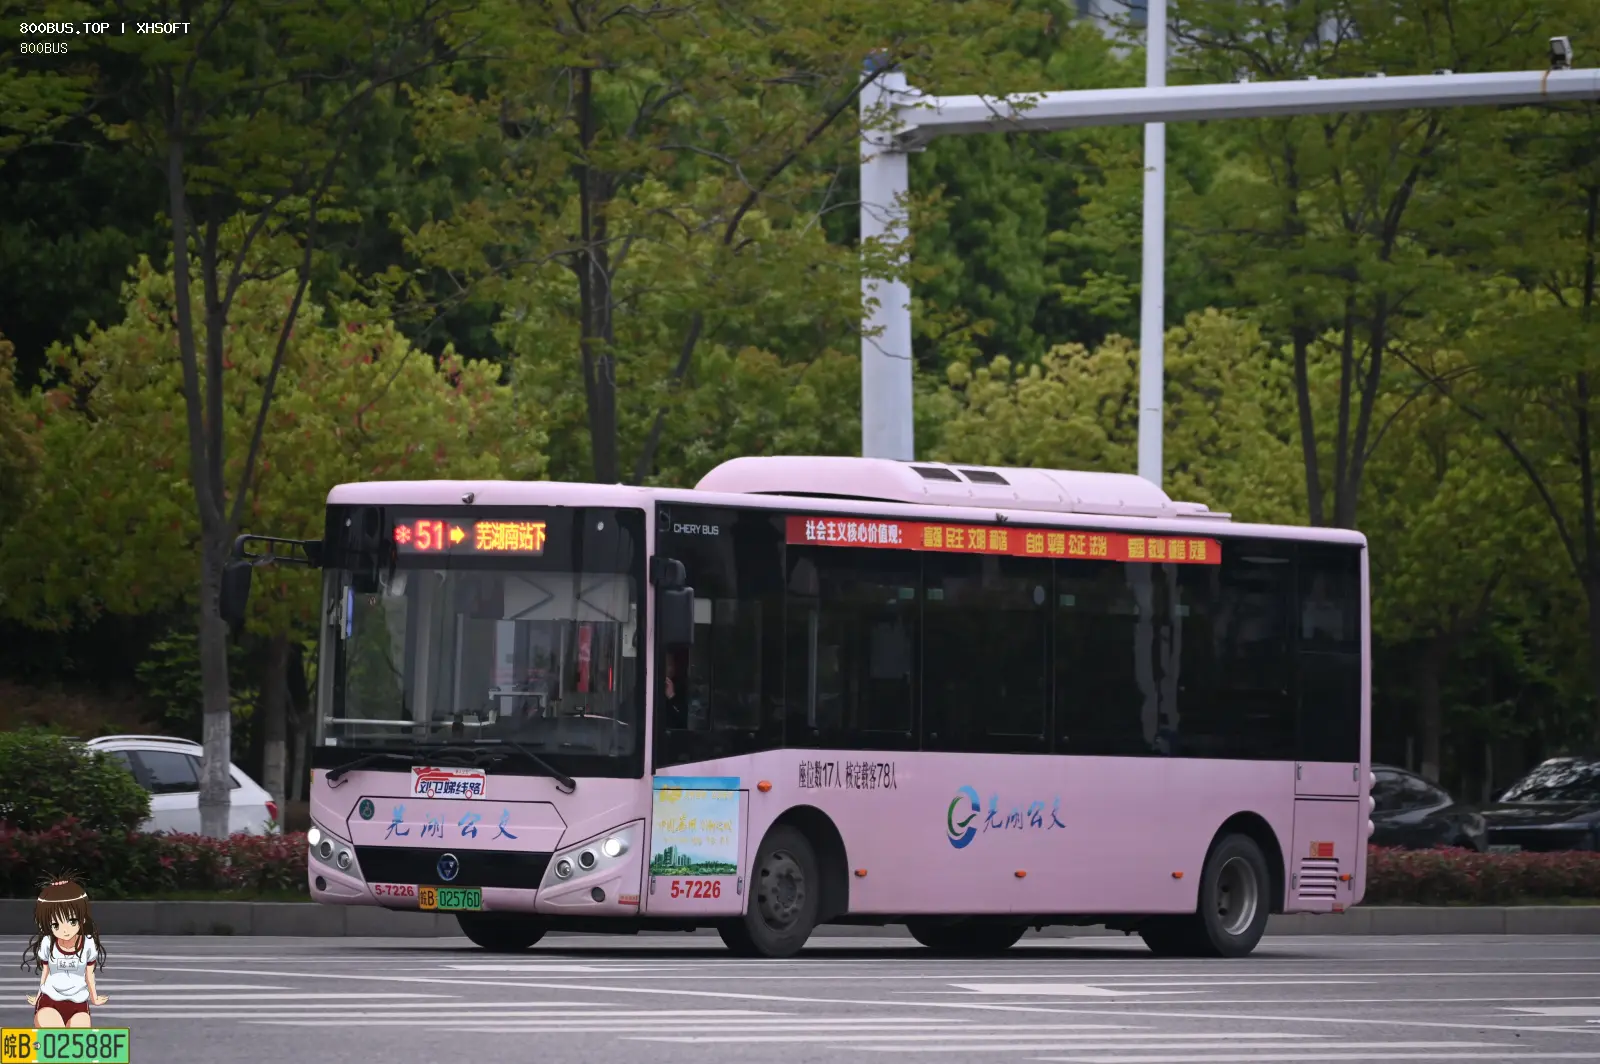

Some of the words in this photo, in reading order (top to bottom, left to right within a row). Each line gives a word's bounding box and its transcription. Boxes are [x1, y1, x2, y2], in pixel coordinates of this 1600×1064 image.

[415, 520, 443, 550] 51
[673, 523, 701, 534] CHERY
[702, 525, 719, 535] BUS
[375, 885, 414, 897] 5-7226
[670, 880, 721, 899] 5-7226
